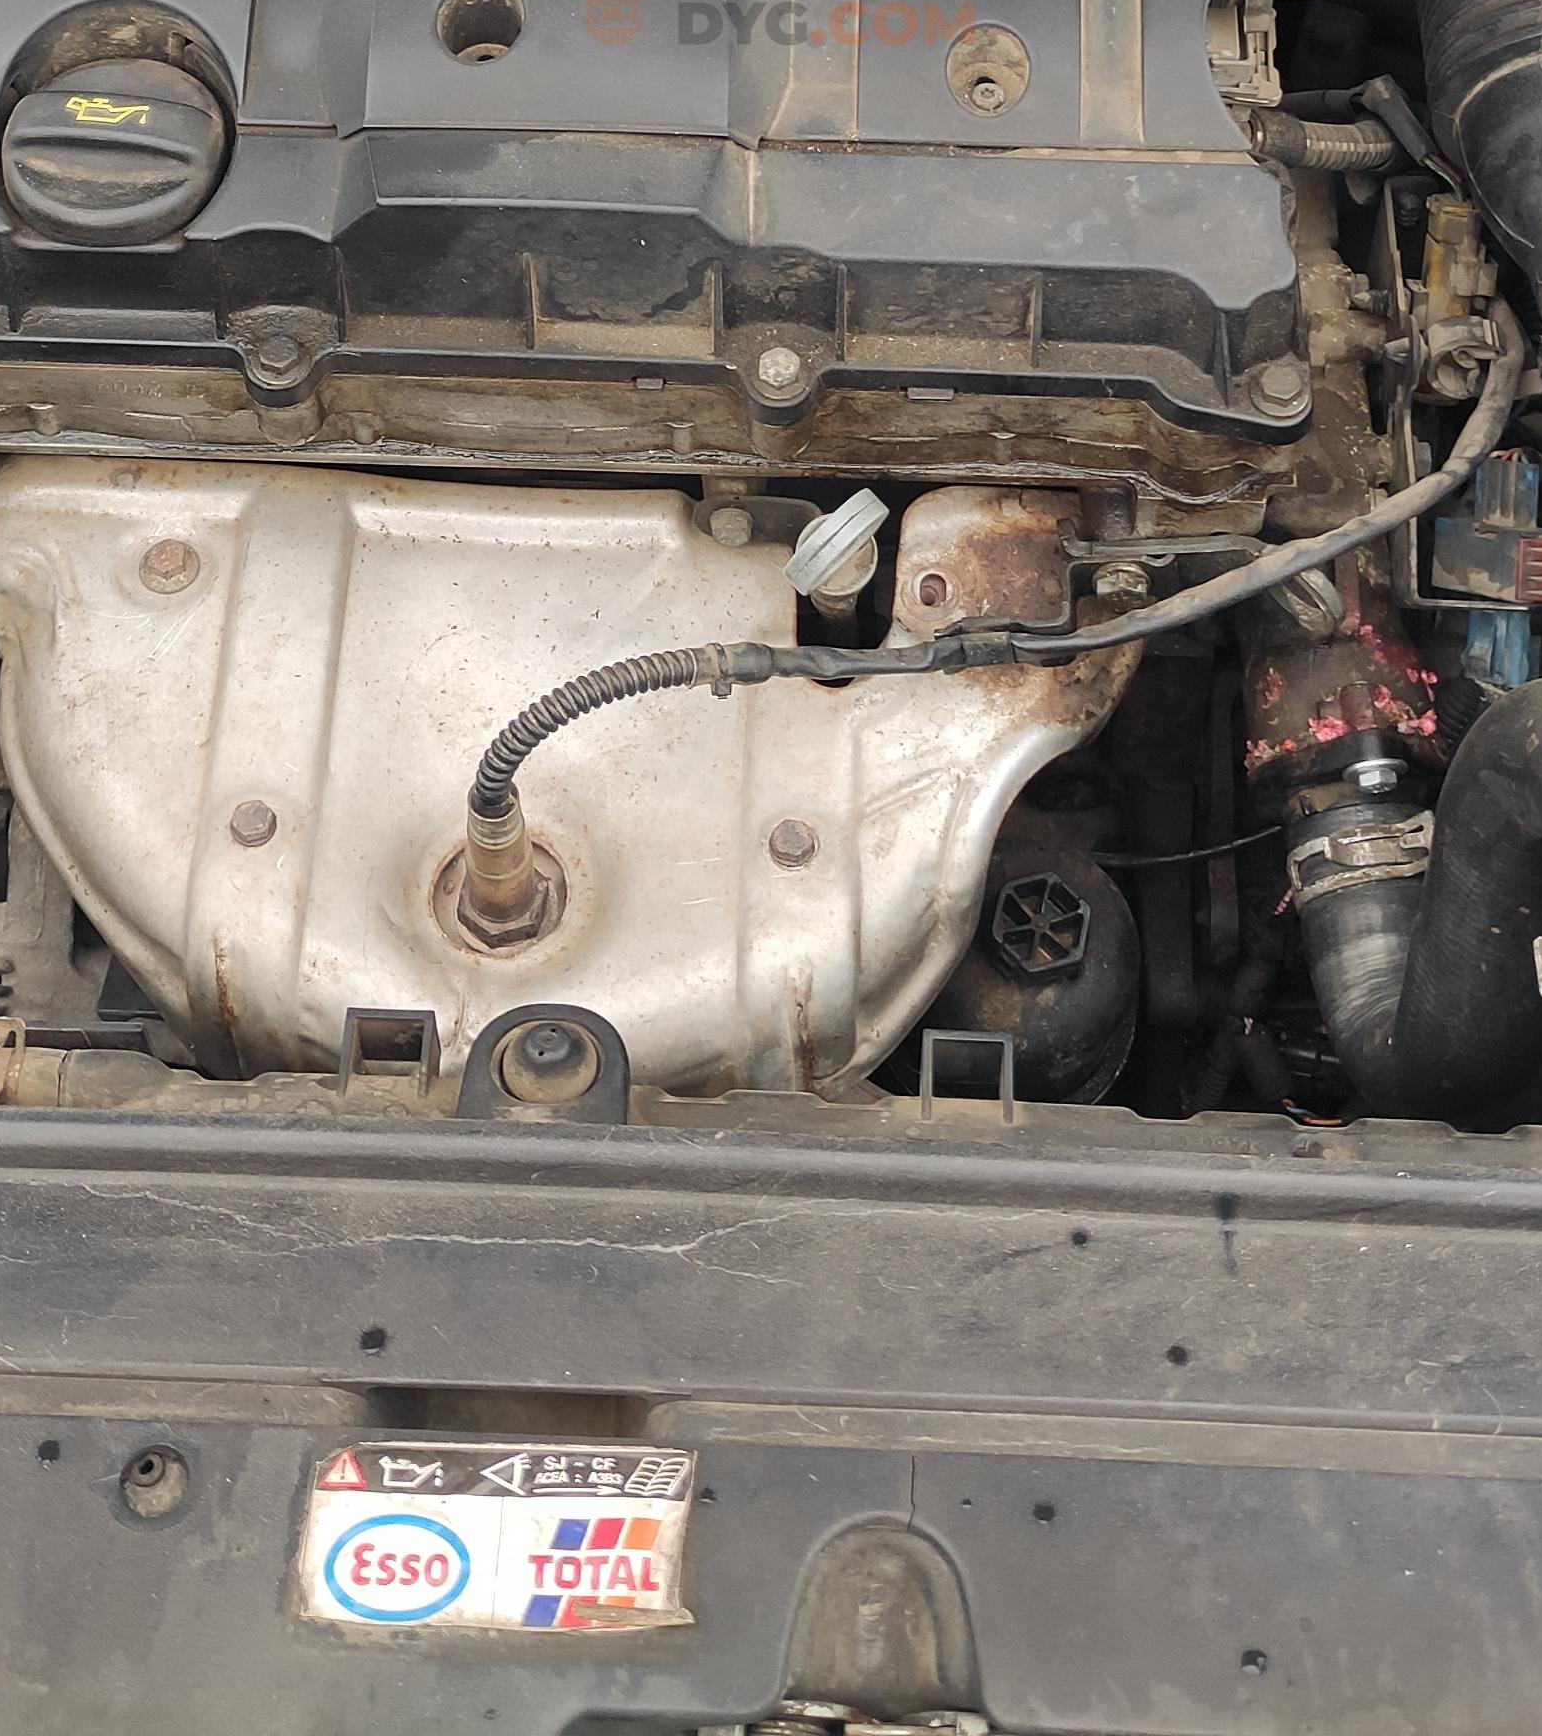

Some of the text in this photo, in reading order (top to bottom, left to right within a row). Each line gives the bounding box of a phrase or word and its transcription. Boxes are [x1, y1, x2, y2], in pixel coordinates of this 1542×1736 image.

[543, 1456, 569, 1471] SJ
[591, 1457, 618, 1471] CF
[530, 1555, 659, 1592] TOTAL
